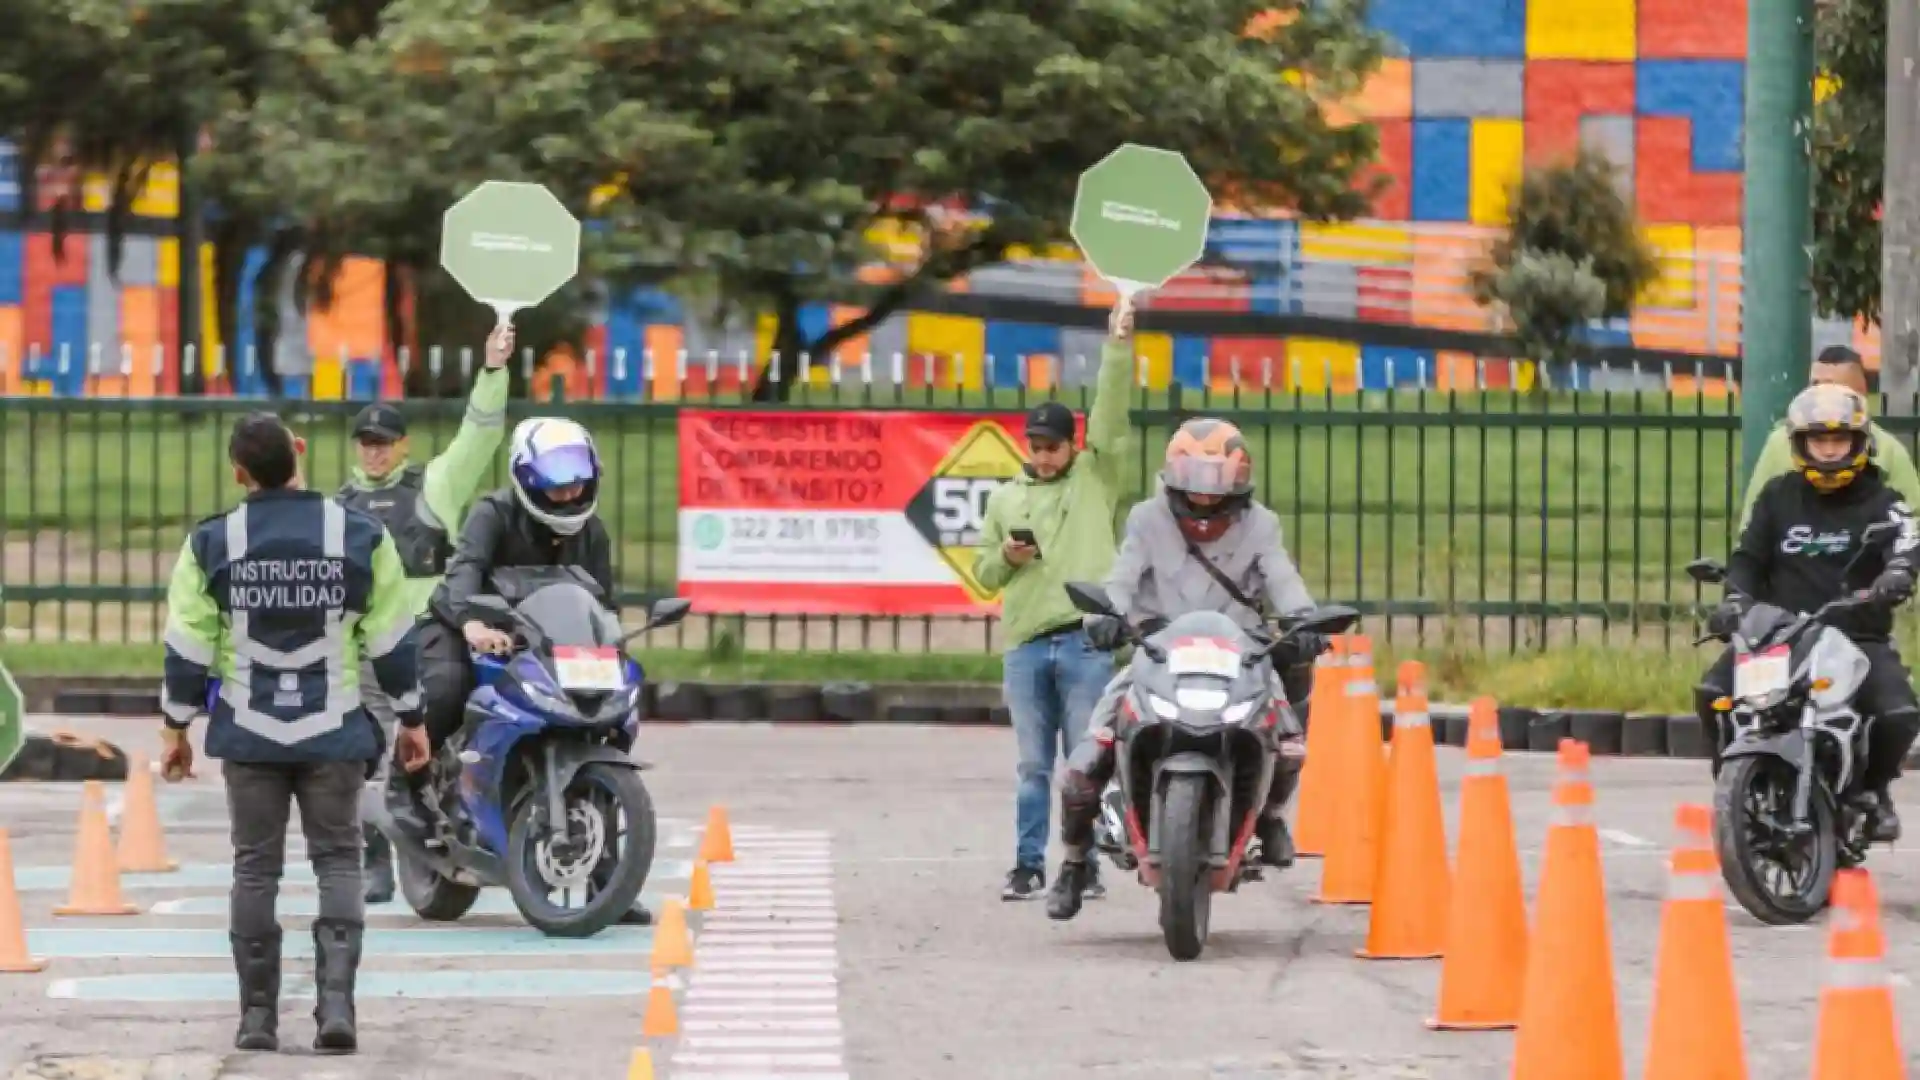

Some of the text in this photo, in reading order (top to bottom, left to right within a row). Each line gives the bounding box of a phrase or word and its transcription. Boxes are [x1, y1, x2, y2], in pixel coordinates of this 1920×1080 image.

[845, 416, 882, 442] UN
[695, 449, 883, 473] COMPARENDO
[230, 560, 344, 581] INSTRUCTOR
[229, 585, 346, 608] MOVILIDAD
